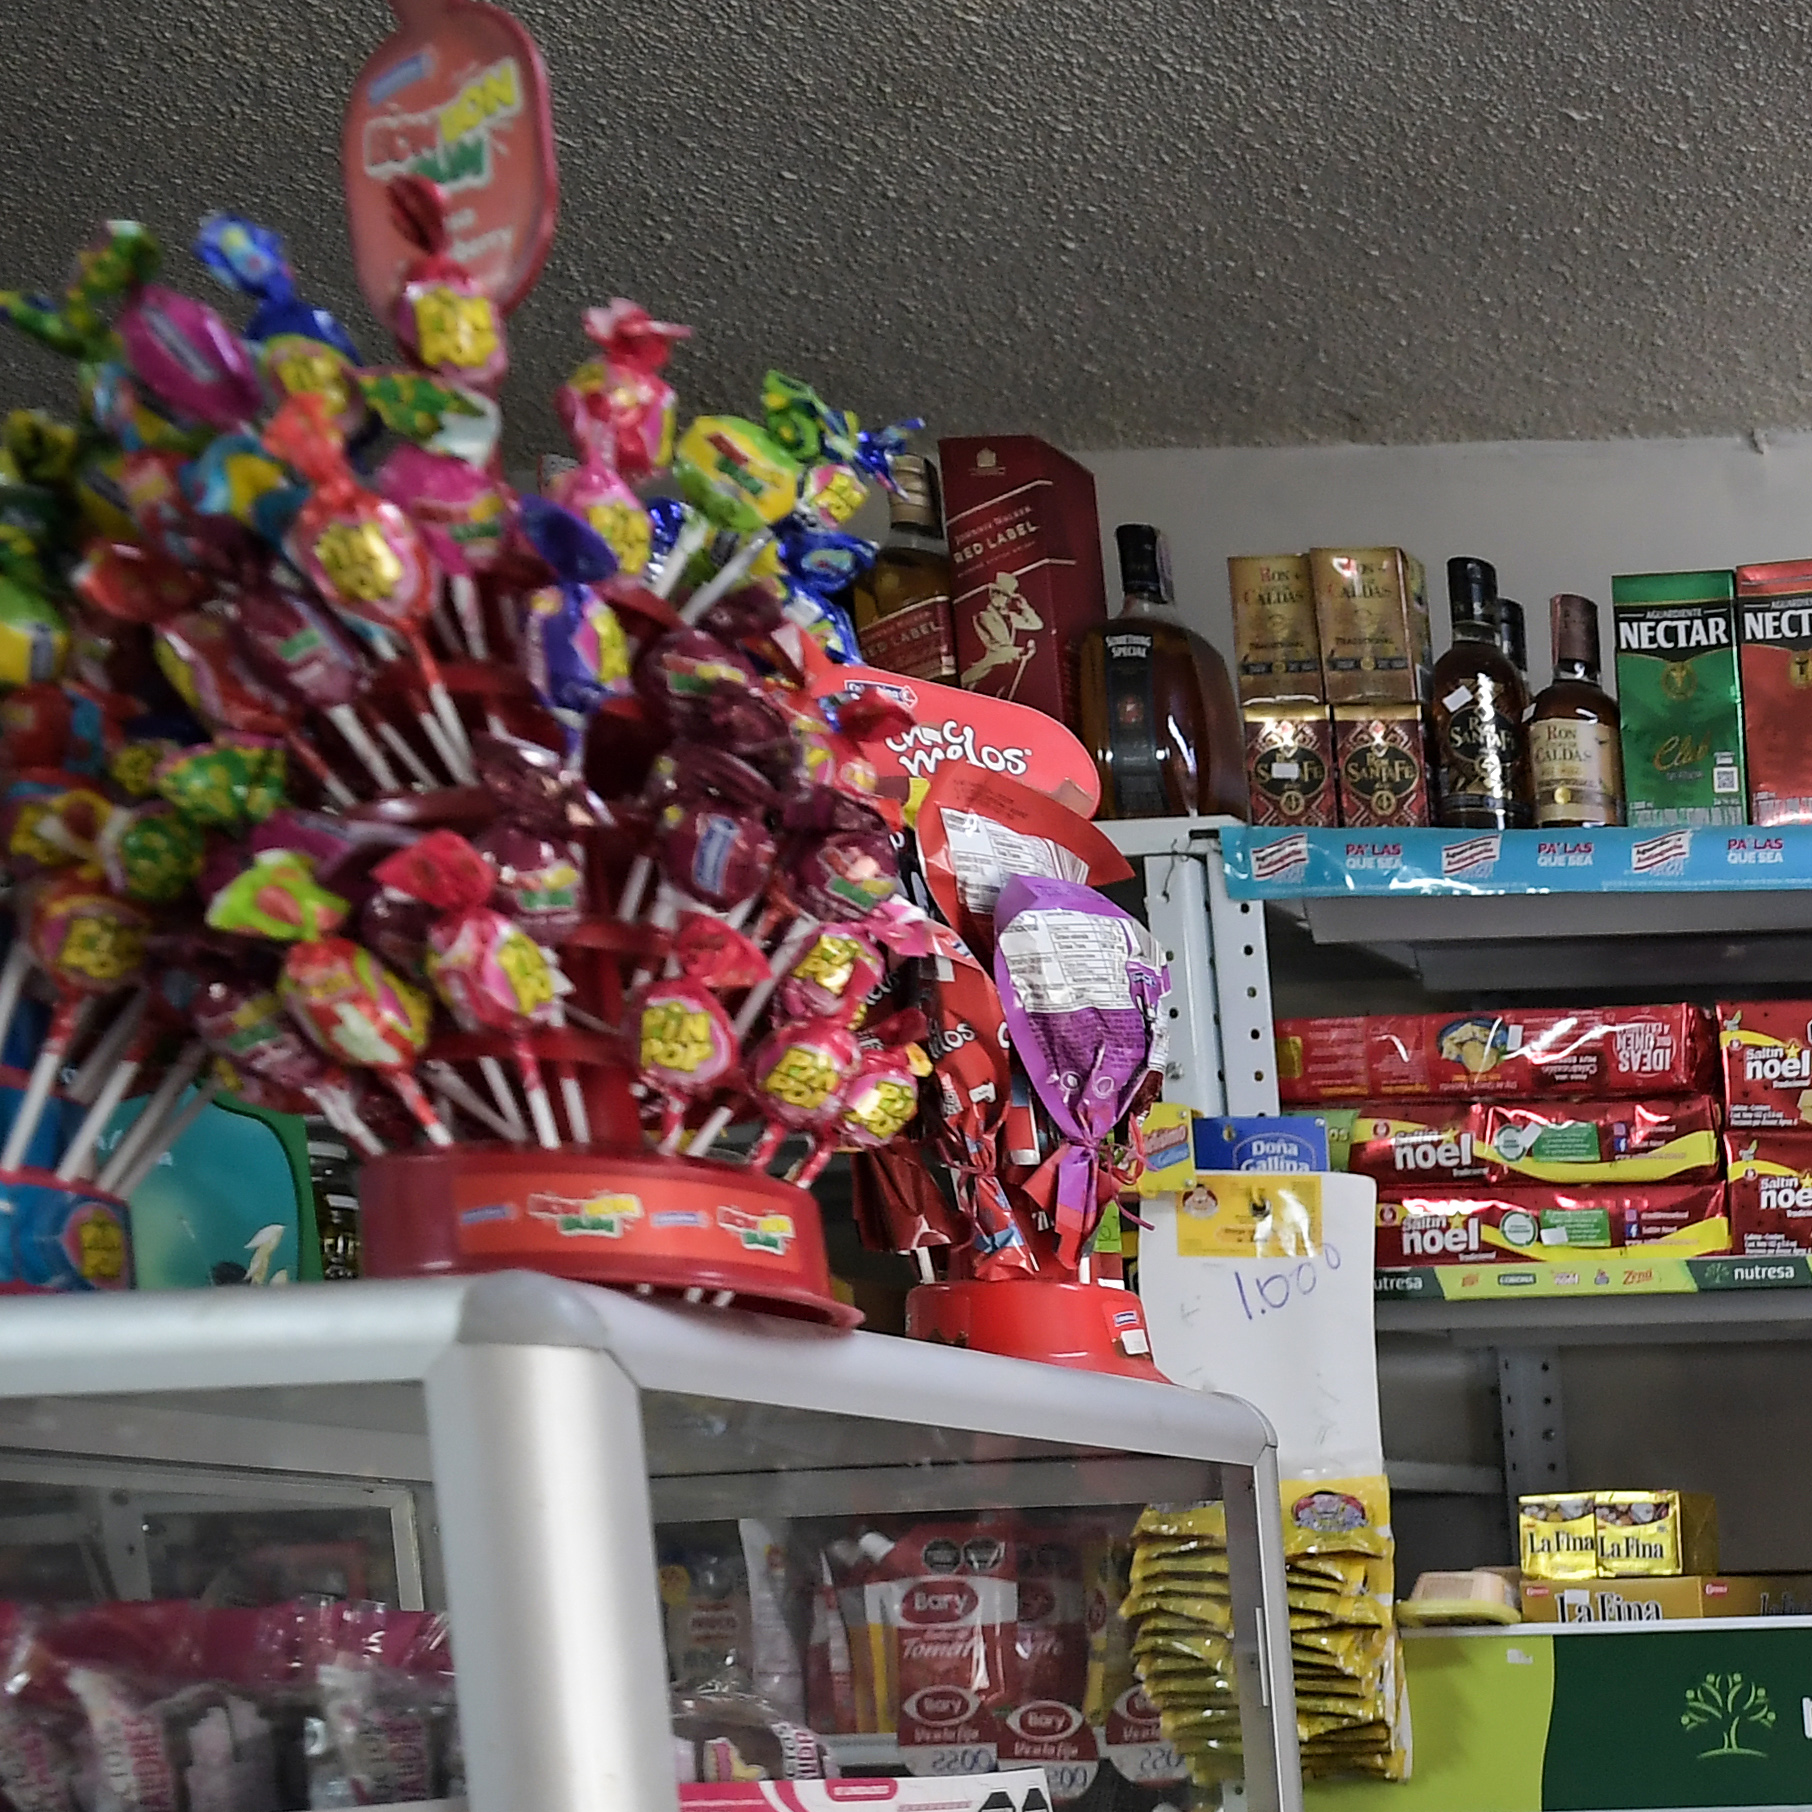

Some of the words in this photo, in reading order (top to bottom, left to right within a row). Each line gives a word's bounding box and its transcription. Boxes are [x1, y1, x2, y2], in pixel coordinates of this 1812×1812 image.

[954, 544, 983, 562] RED
[987, 522, 1039, 549] LABEL
[1619, 617, 1728, 650] NECTAR
[1745, 1056, 1810, 1079] noel
[1252, 1140, 1298, 1158] Doña
[1395, 1136, 1474, 1169] noel
[1734, 1264, 1794, 1281] nutresa
[1600, 1536, 1620, 1558] La
[1624, 1537, 1664, 1558] Fina
[1556, 1592, 1594, 1623] La
[1596, 1591, 1663, 1620] Fina
